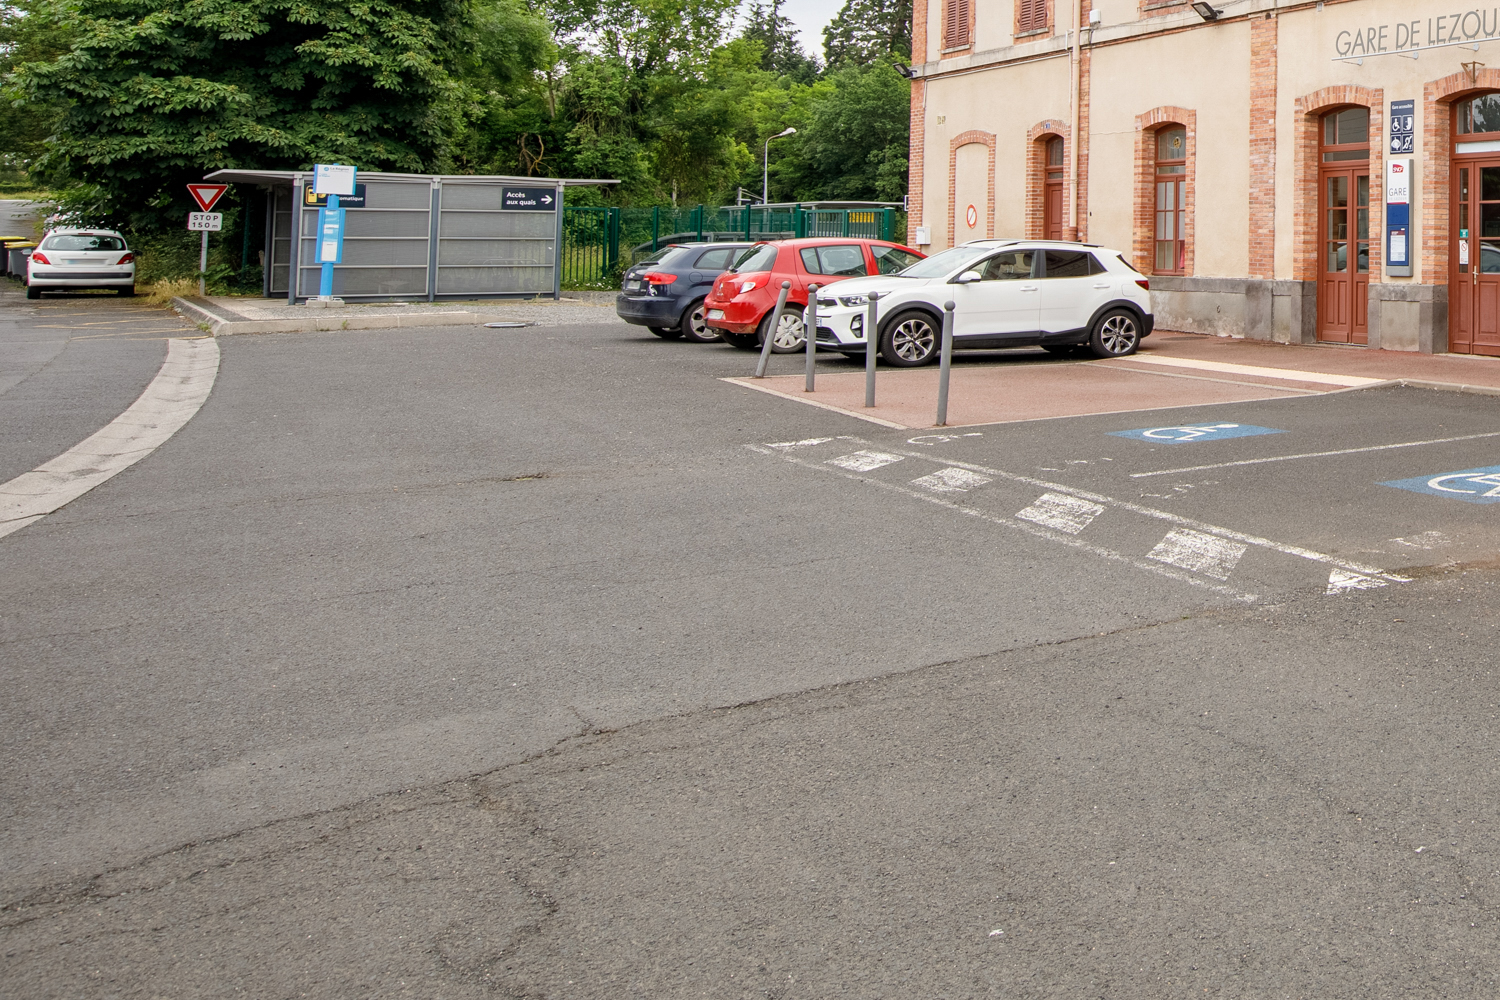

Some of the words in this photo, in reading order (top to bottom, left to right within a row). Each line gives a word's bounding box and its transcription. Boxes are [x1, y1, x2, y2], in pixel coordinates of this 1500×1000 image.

[1335, 25, 1389, 57] GARE
[1396, 20, 1421, 52] DE
[1389, 187, 1407, 197] GARE
